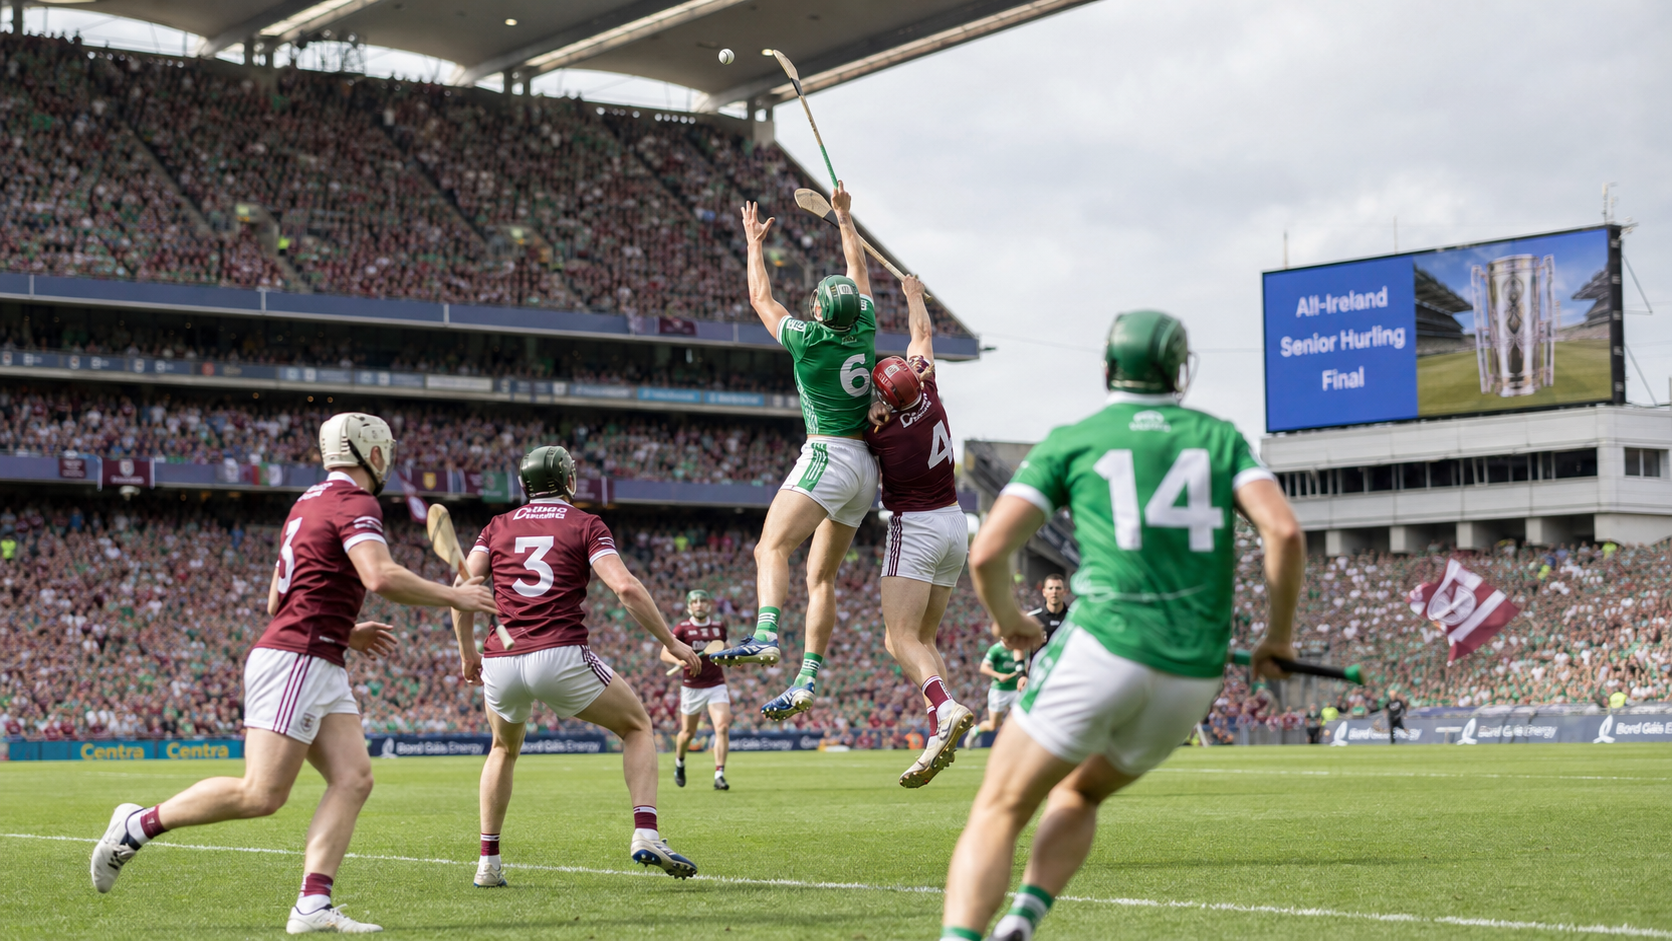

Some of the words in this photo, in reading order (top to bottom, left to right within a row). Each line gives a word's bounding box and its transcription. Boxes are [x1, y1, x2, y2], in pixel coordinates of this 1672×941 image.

[1296, 285, 1388, 318] All-Ireland
[1280, 333, 1336, 358] Senior
[1341, 324, 1406, 351] Hurling
[840, 353, 871, 398] 6
[1322, 366, 1365, 391] Final
[927, 420, 953, 470] 4
[1093, 448, 1225, 552] 14
[511, 536, 554, 597] 3
[1616, 722, 1642, 734] Bord
[80, 742, 145, 760] Centra
[166, 741, 229, 759] Centra
